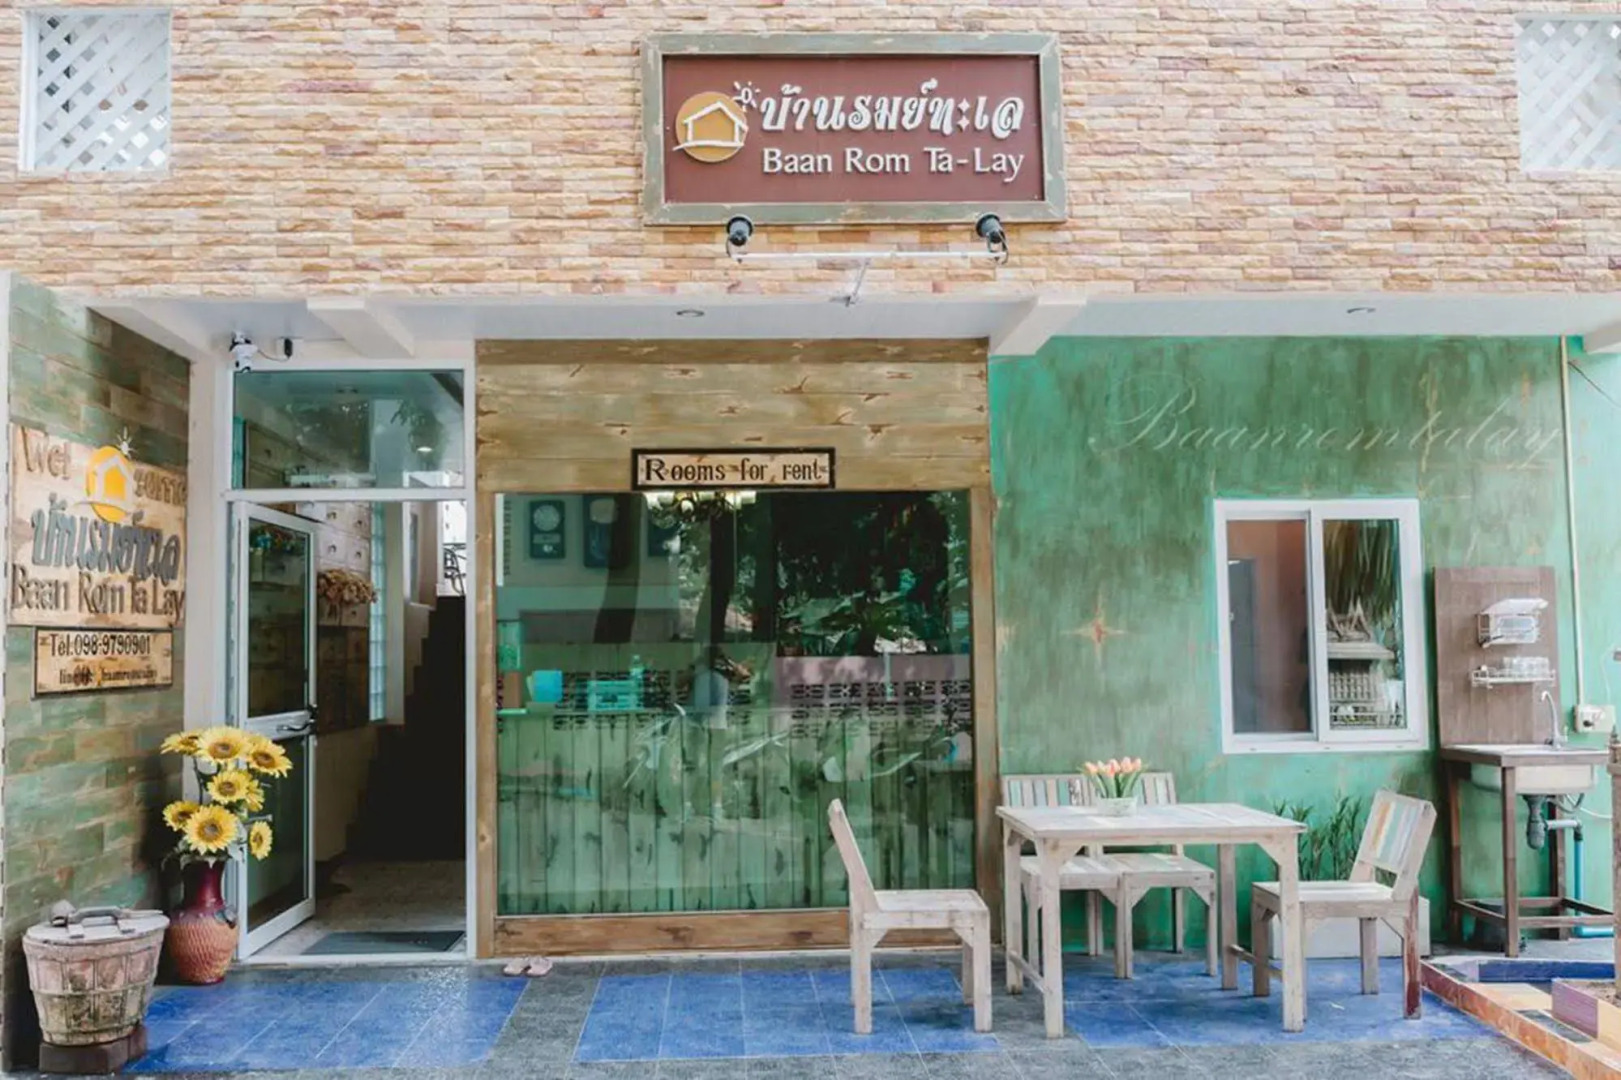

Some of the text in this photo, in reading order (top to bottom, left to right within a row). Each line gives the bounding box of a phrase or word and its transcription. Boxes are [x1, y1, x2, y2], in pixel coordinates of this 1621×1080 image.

[760, 78, 1025, 139] บ้านรมย์ทะเล
[762, 147, 1025, 183] Baan Rom Ta-Lay
[645, 457, 824, 482] Rooms for rent
[12, 562, 70, 612] Baan
[78, 571, 125, 615] Rom
